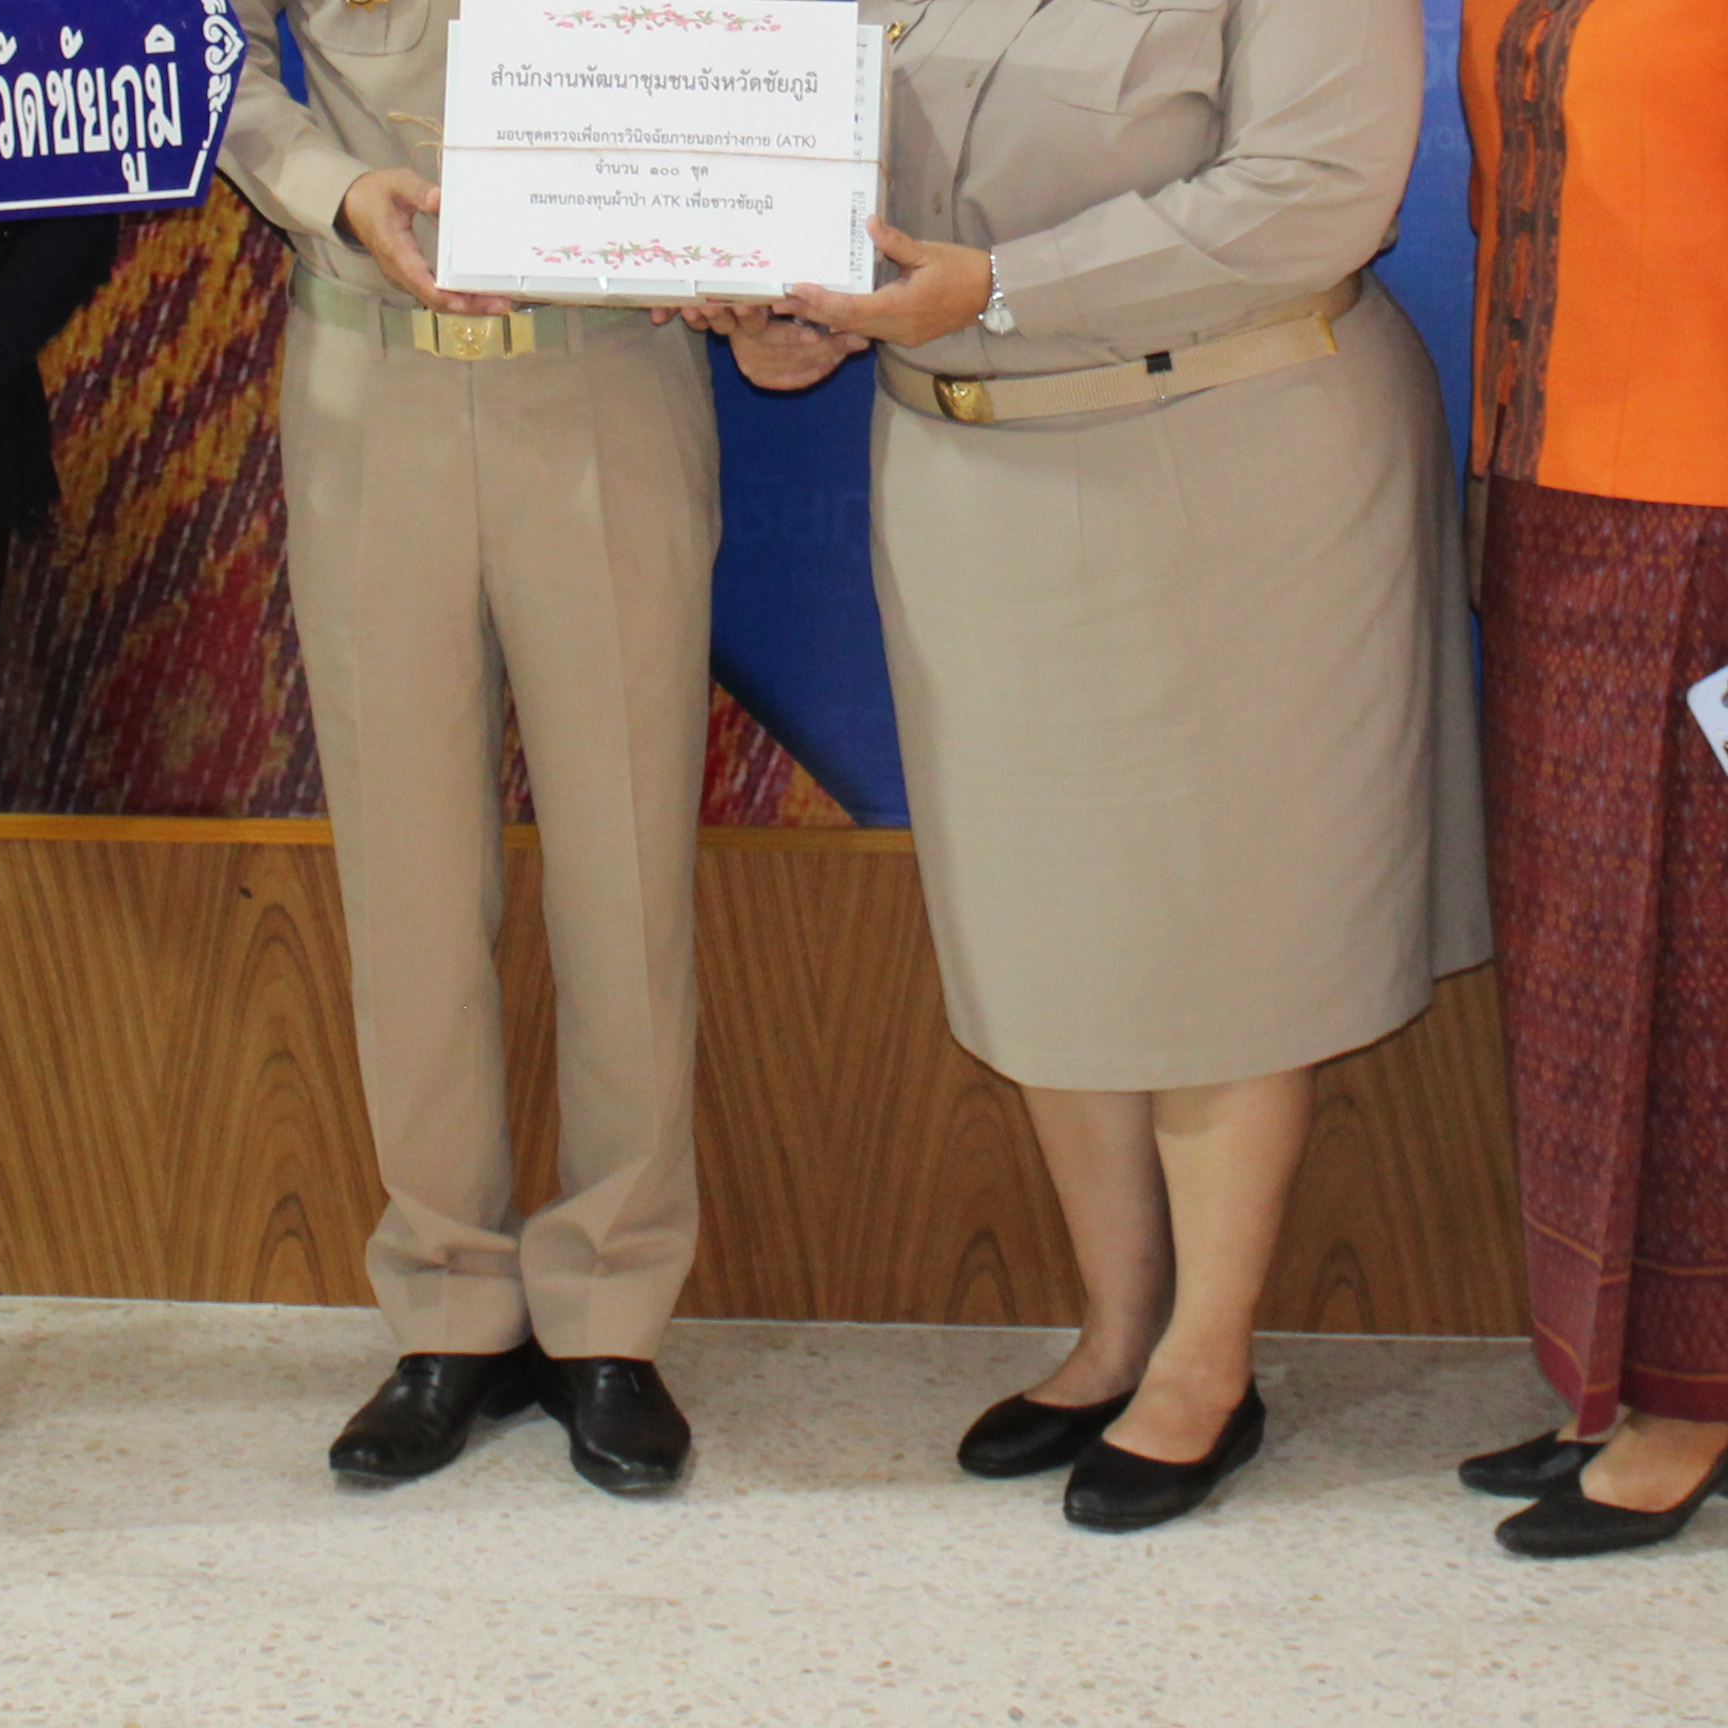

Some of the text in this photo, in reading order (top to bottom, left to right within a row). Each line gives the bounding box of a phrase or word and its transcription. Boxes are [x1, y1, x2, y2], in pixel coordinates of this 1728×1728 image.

[490, 63, 819, 102] สำนักงานพัฒนาชุมชนจังหวัดชัยภูมิ
[776, 133, 817, 149] (ATK)
[650, 194, 681, 209] ATK
